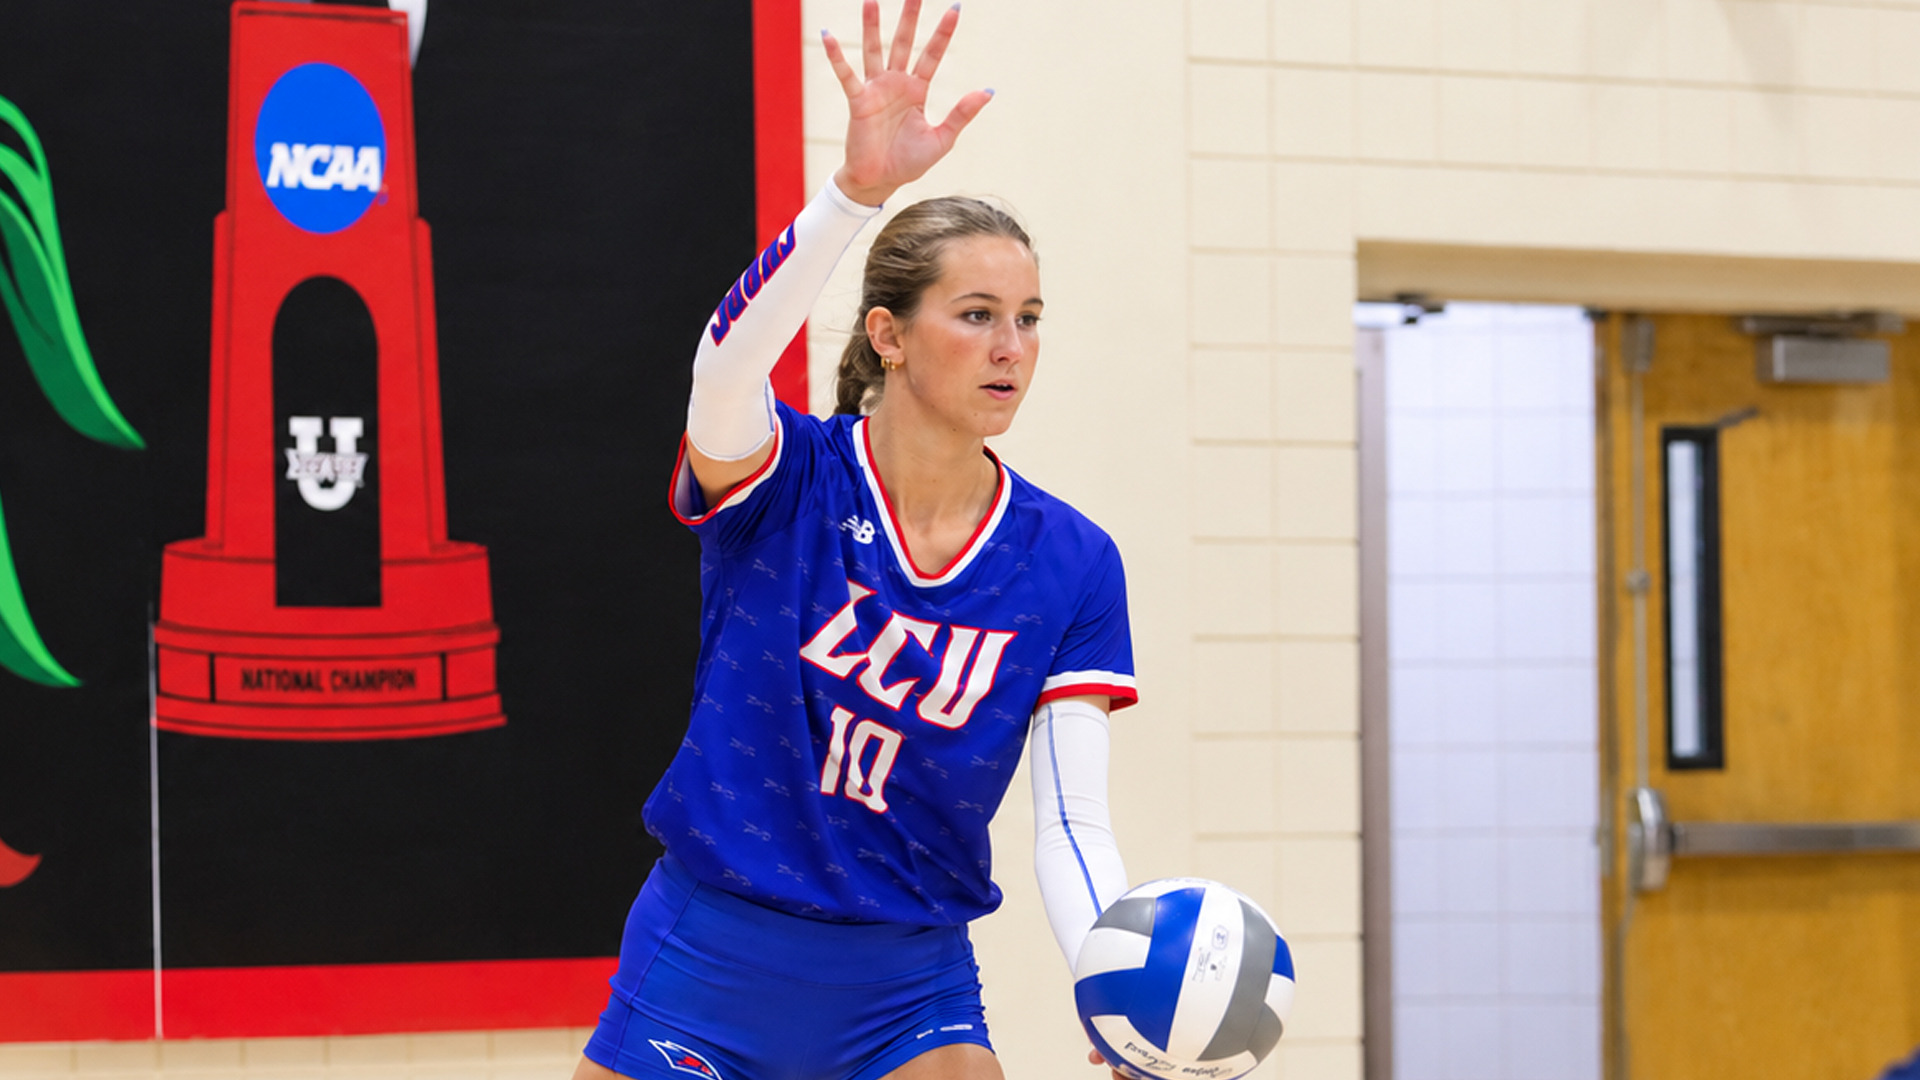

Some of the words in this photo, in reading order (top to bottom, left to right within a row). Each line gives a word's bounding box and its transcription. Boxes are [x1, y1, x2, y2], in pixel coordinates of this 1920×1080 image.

[266, 142, 381, 192] NCAA
[241, 667, 325, 692] NATIONAL
[331, 667, 417, 692] CHAMPION
[799, 578, 1019, 730] LCU
[820, 704, 904, 814] 10
